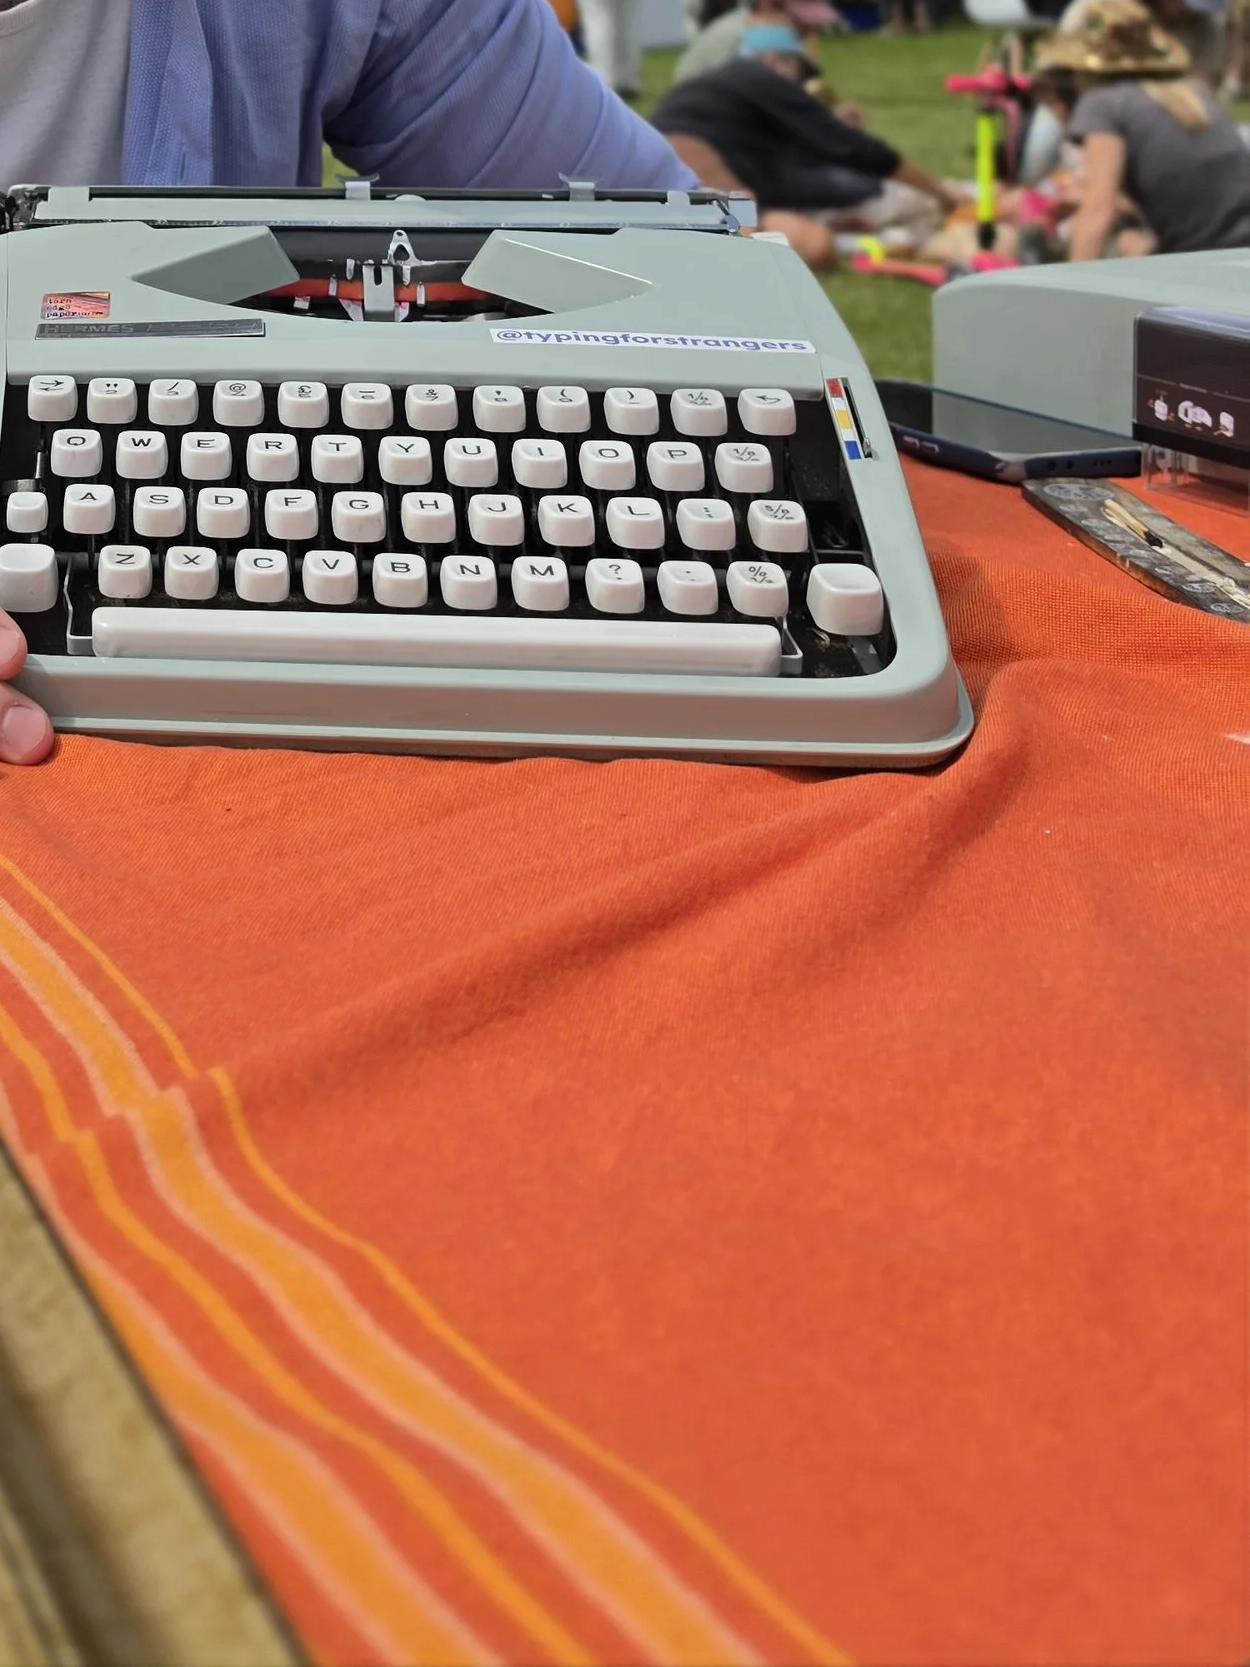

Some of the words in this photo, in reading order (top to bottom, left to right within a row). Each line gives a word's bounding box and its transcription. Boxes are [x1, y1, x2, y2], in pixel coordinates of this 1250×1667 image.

[496, 330, 807, 351] @typingforstrangers
[66, 436, 87, 447] Q
[131, 437, 152, 447] W
[196, 439, 215, 449] E
[264, 440, 283, 450] R
[328, 441, 347, 452] T
[396, 443, 415, 453] Y
[461, 445, 482, 455] U
[597, 448, 620, 458] O
[667, 449, 688, 459] P
[79, 492, 97, 501] A
[149, 494, 170, 505] S
[214, 495, 234, 505] D
[283, 496, 302, 507] F
[348, 499, 370, 510] G
[418, 499, 440, 510] H
[487, 501, 507, 513] J
[557, 503, 578, 513] K
[627, 505, 649, 516] L
[115, 553, 135, 565] Z
[183, 553, 201, 566] X
[253, 557, 274, 569] C
[321, 558, 340, 570] V
[390, 561, 411, 574] B
[459, 564, 481, 576] N
[529, 564, 555, 577] M
